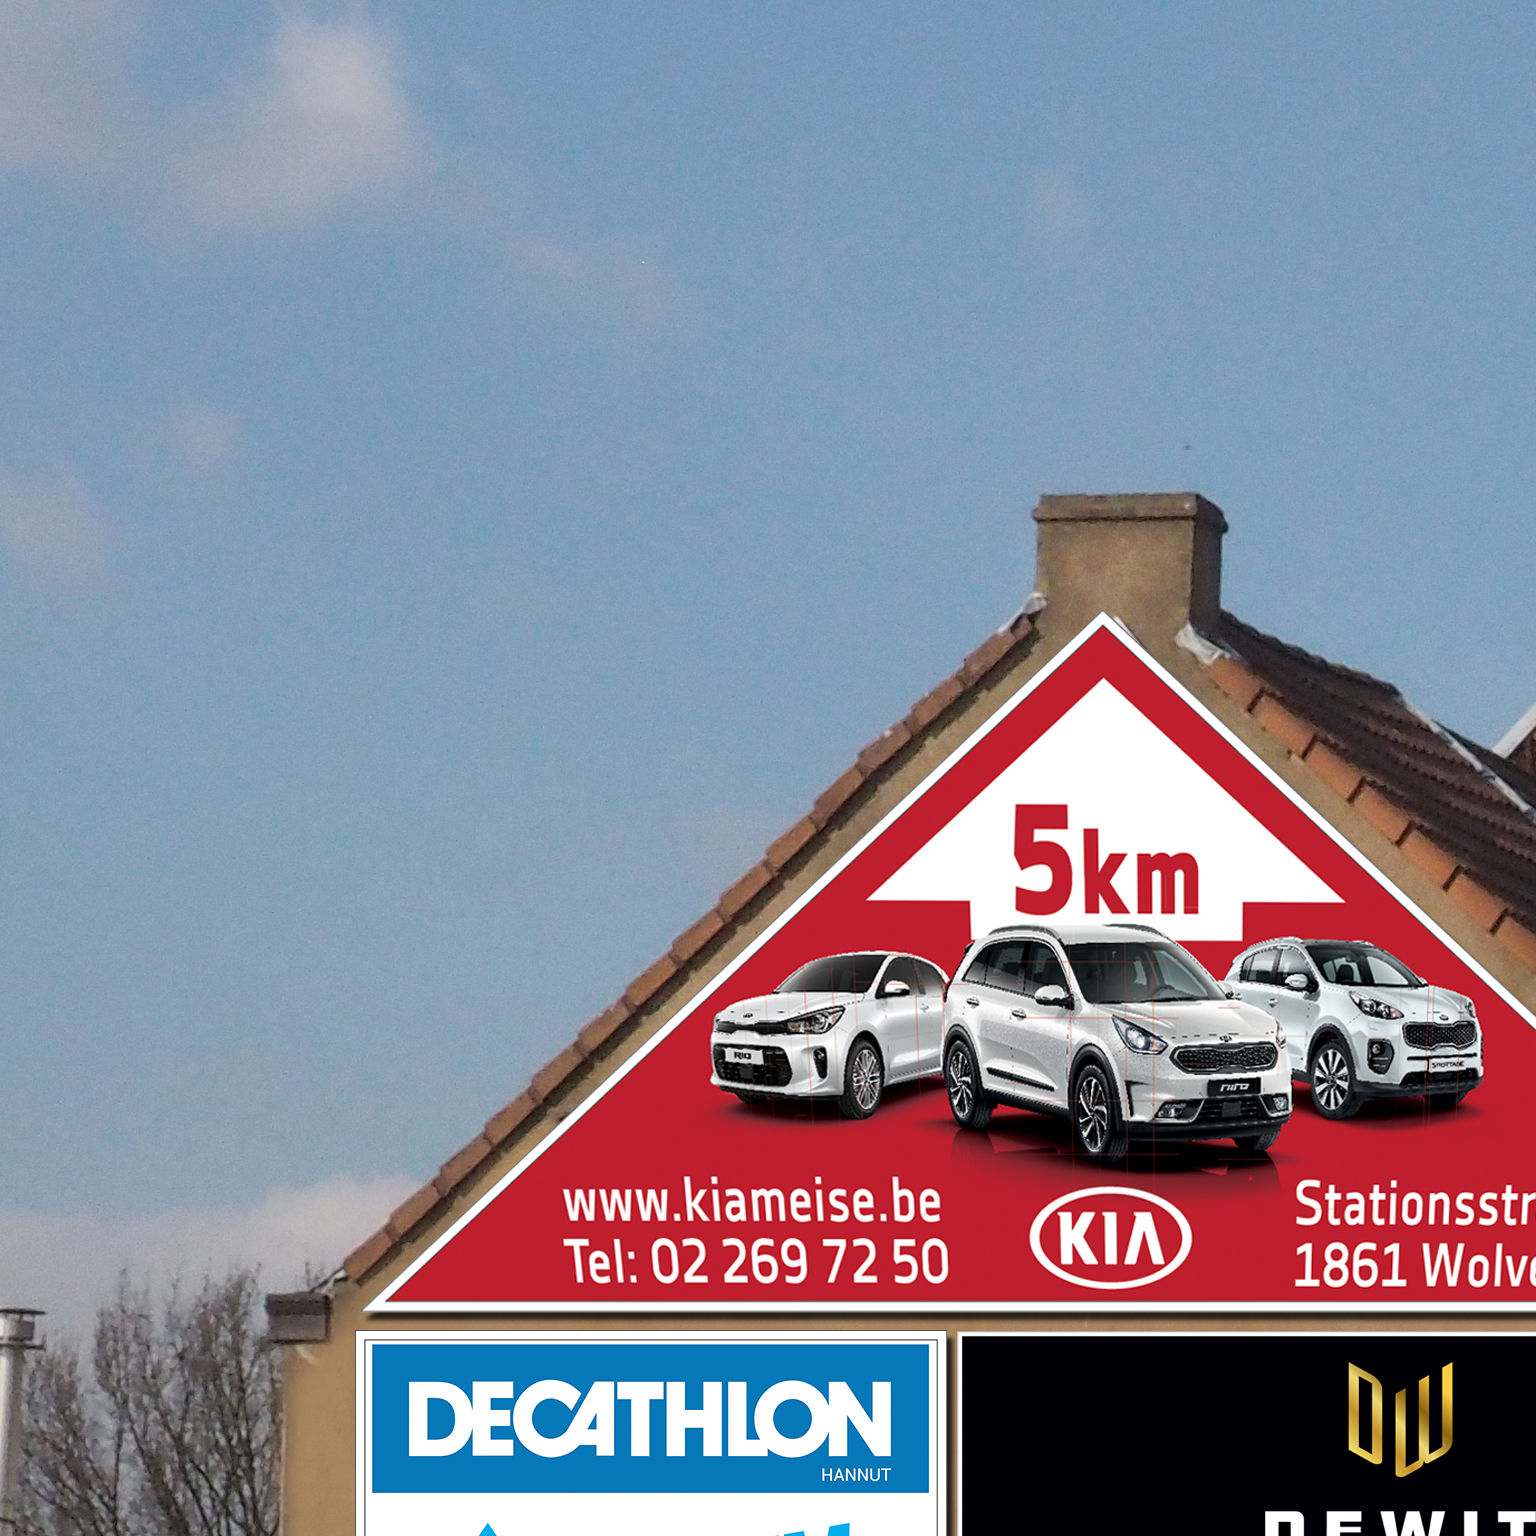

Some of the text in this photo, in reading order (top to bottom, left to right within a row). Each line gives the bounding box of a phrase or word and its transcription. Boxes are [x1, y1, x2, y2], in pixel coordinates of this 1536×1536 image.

[1014, 804, 1199, 915] 5km
[563, 1176, 941, 1223] www.kiameise.be
[563, 1238, 949, 1284] Tel: 02 269 72 50
[1059, 1211, 1166, 1266] KIA
[1294, 1242, 1407, 1288] 1861
[408, 1379, 892, 1458] DECATHLON
[821, 1467, 892, 1482] HANNUT
